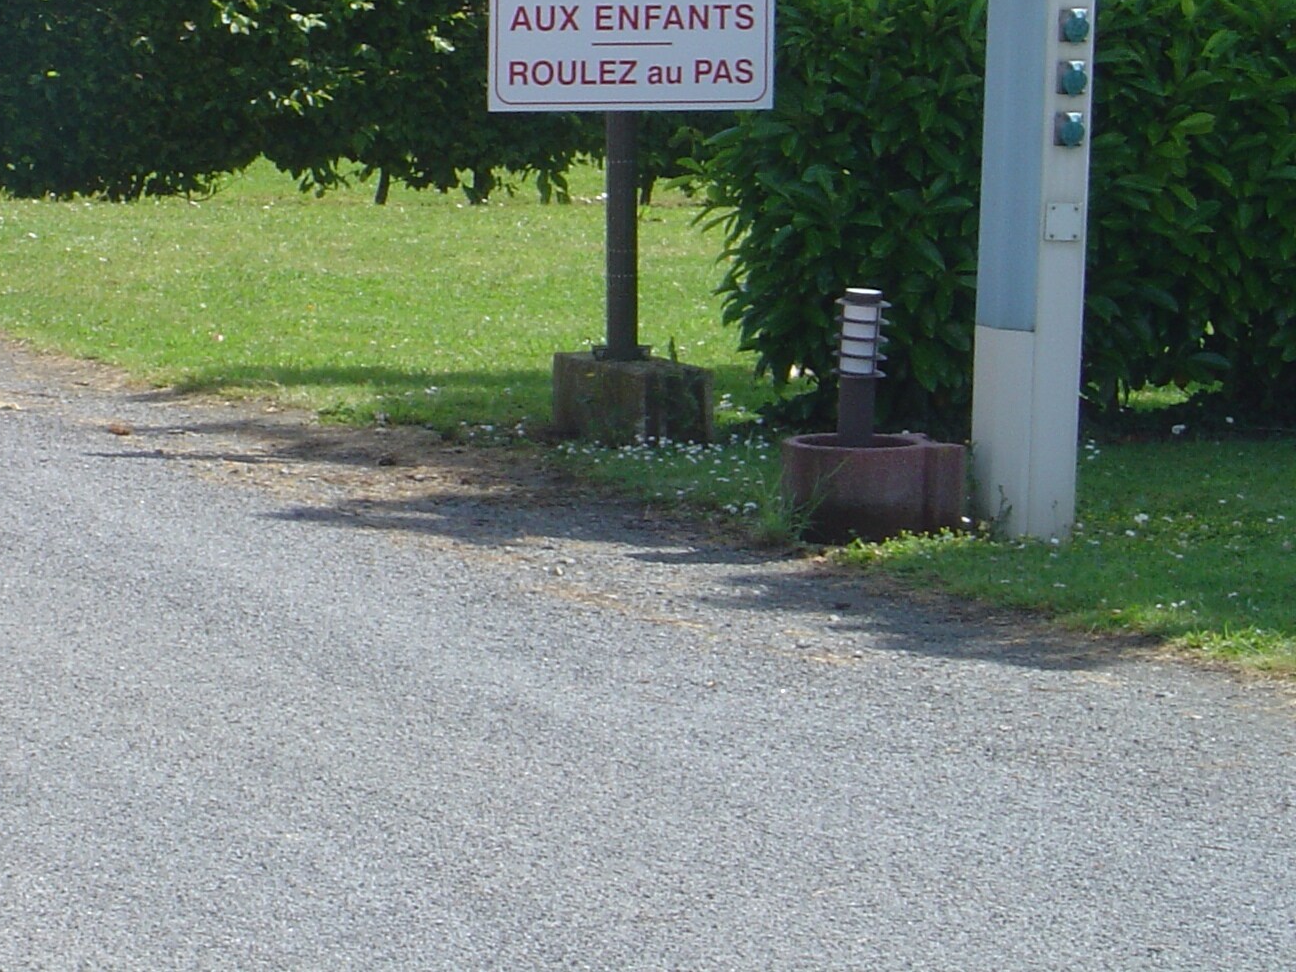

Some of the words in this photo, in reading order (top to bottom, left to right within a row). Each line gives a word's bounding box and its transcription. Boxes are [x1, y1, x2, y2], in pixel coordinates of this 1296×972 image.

[510, 5, 579, 31] AUX
[595, 3, 754, 30] ENFANTS
[509, 60, 637, 86] ROULEZ
[647, 65, 682, 85] au
[694, 58, 754, 84] PAS
